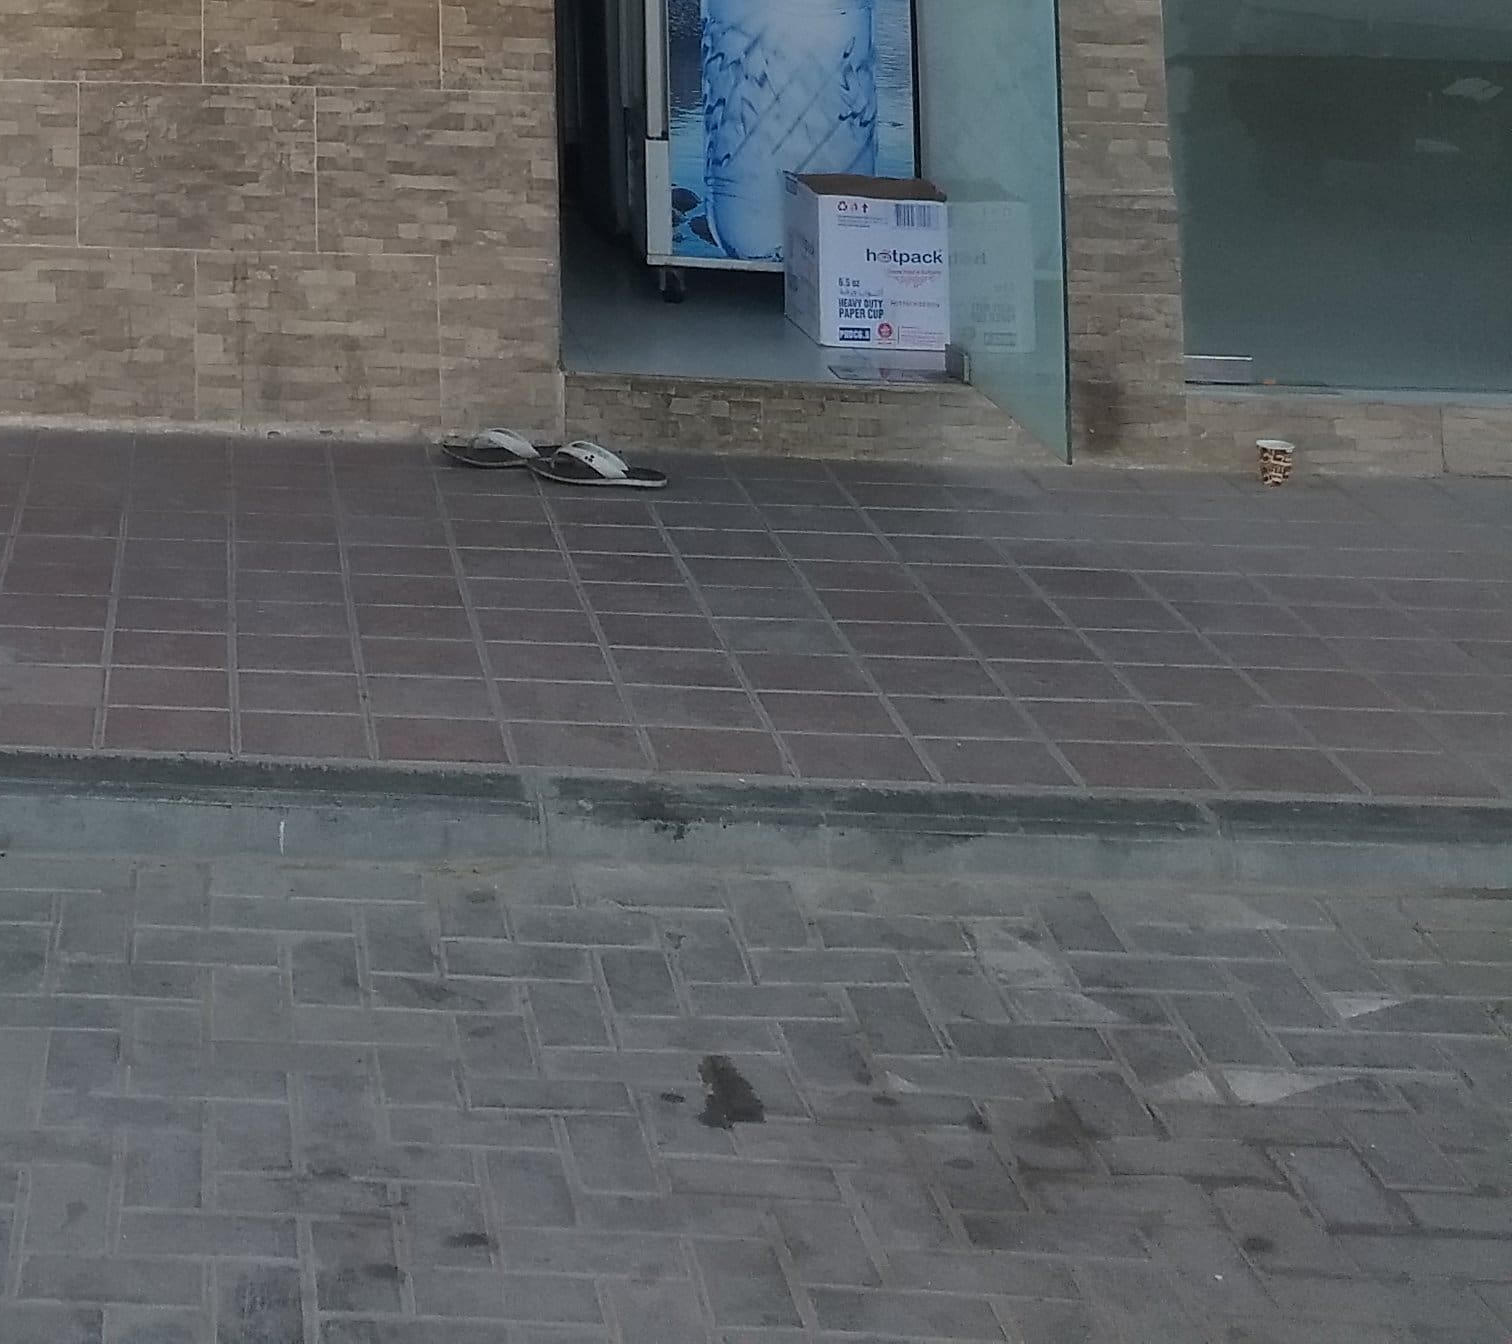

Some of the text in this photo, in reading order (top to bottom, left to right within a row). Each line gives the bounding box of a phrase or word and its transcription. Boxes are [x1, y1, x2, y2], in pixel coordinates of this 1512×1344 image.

[866, 248, 943, 266] hotpack
[838, 298, 863, 308] HEAVY
[864, 299, 883, 309] DUTY
[839, 308, 884, 320] PAPER CUP
